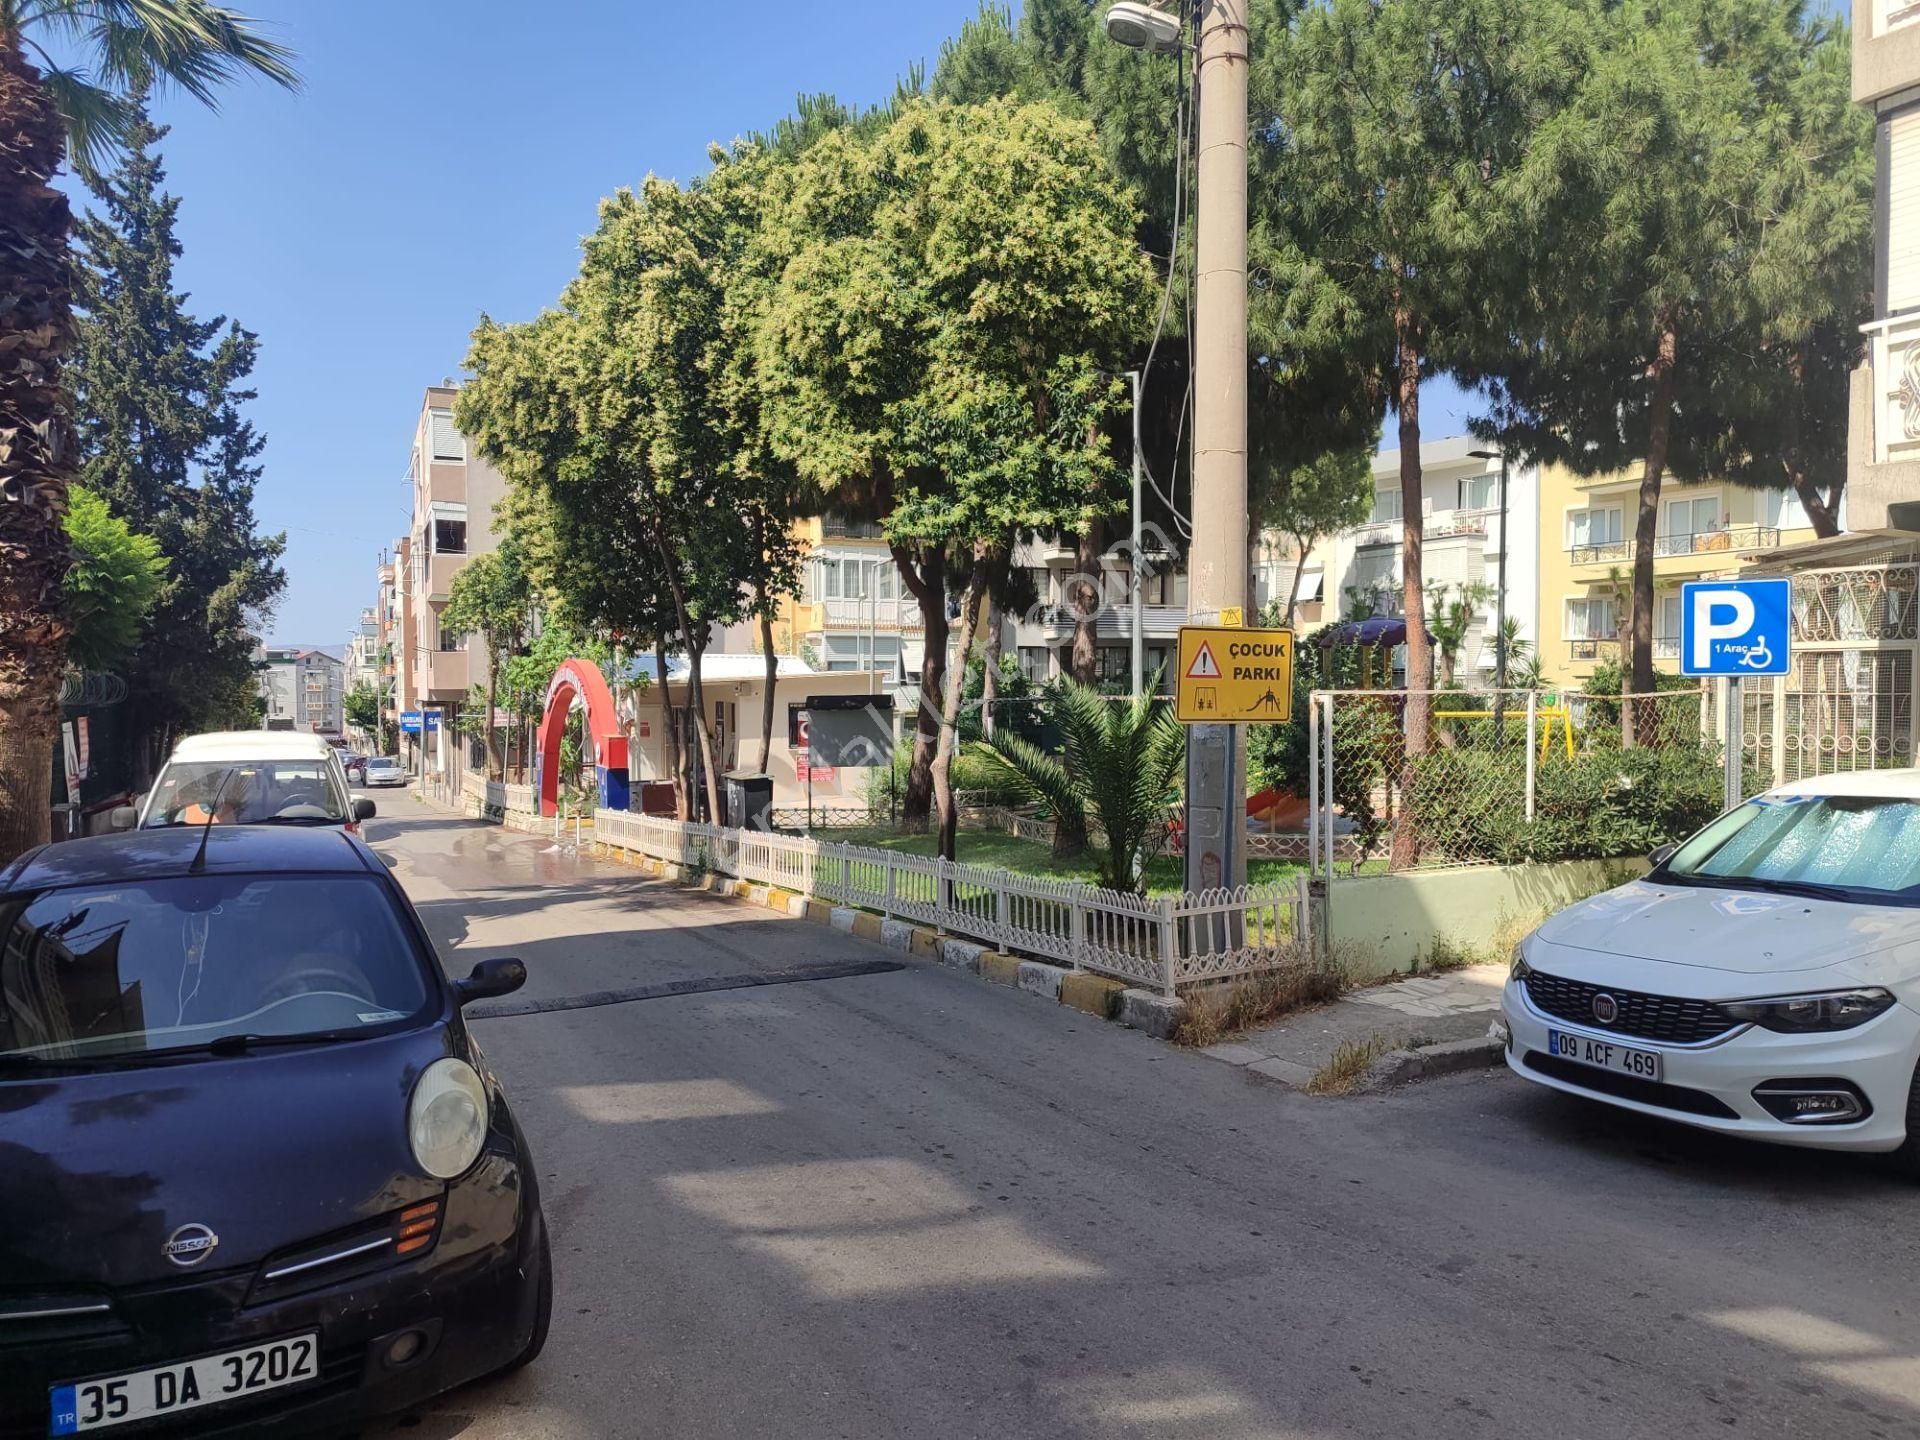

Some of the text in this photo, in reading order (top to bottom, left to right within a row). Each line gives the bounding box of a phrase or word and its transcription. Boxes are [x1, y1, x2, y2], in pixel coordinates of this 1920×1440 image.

[1694, 590, 1755, 668] P
[1229, 643, 1285, 659] ÇOCUK
[1715, 644, 1748, 655] 1 Araç
[1233, 667, 1280, 680] PARKI
[1560, 1035, 1655, 1076] 09 ACF 469
[80, 1340, 311, 1424] 35 DA 3202
[57, 1413, 75, 1426] TR
